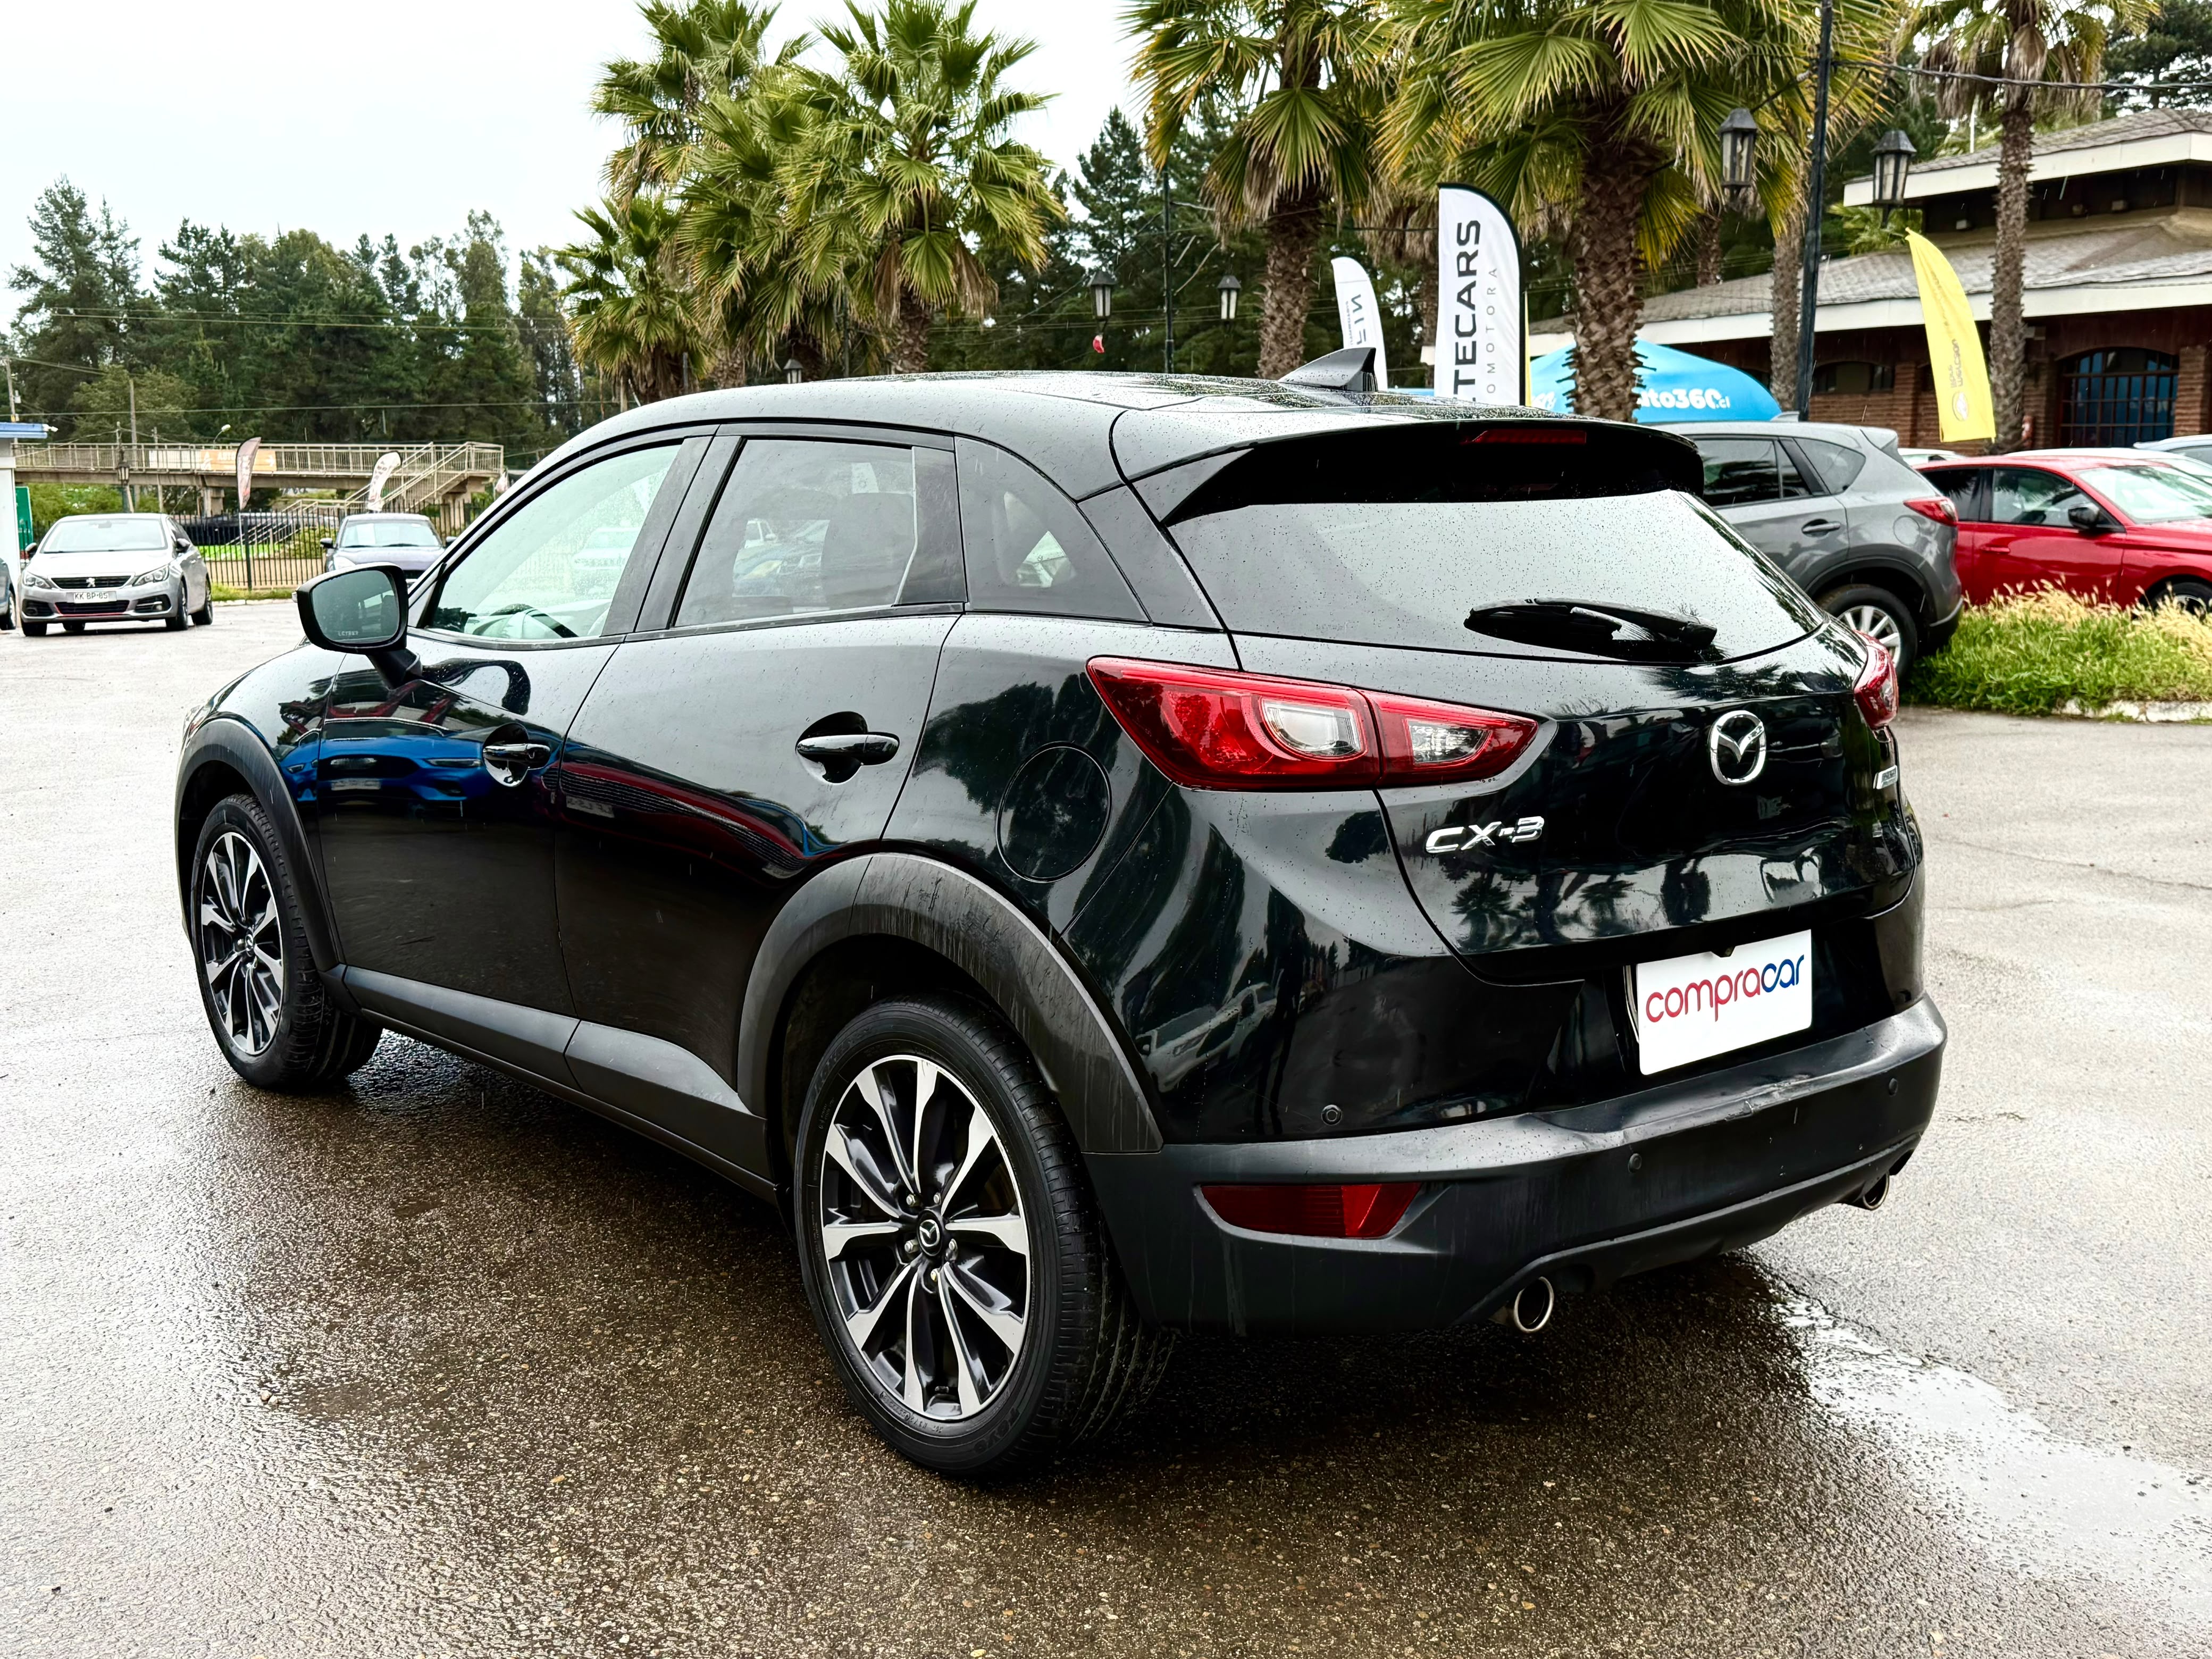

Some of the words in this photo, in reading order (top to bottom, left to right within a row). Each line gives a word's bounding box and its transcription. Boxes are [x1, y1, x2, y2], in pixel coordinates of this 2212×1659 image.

[1453, 220, 1481, 401] TECARS
[1486, 267, 1498, 394] OMOTORA
[1426, 816, 1545, 853] CX-3
[1646, 954, 1805, 1023] compracar
